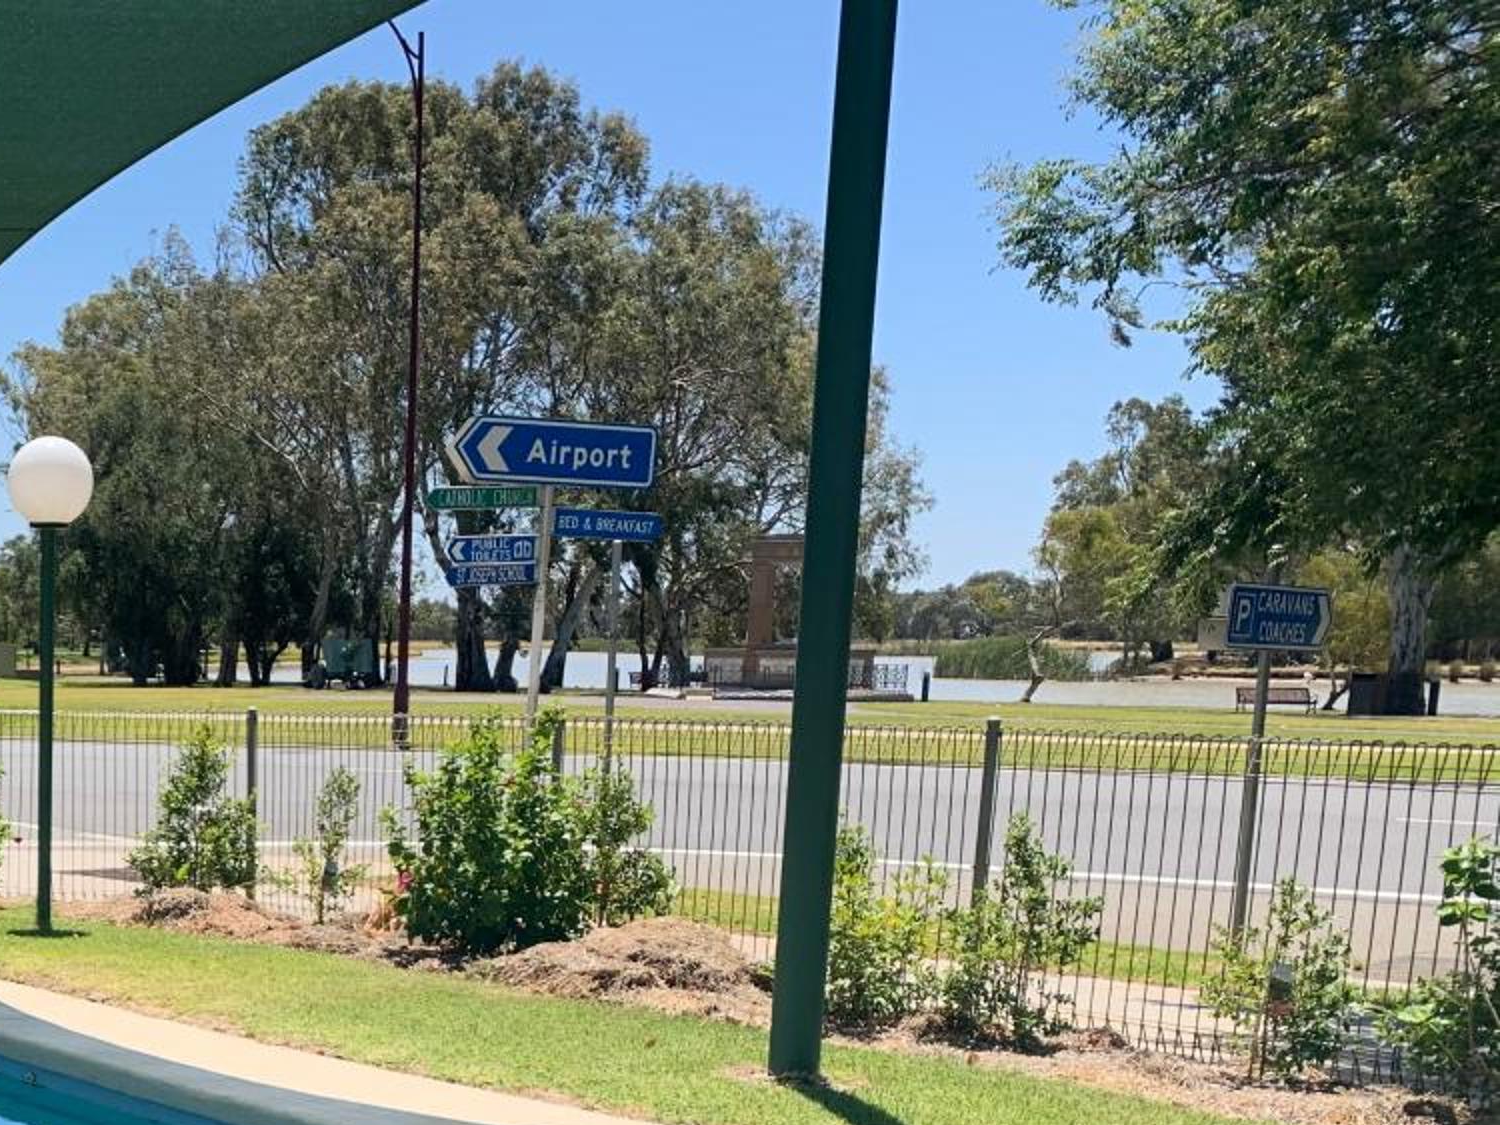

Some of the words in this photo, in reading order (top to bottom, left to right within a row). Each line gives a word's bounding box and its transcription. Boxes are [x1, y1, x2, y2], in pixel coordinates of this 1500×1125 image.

[526, 438, 632, 471] Airport
[558, 515, 579, 529] BED
[583, 517, 592, 531] &
[596, 517, 654, 534] BREAKFAST
[471, 537, 511, 550] PUBLIC
[471, 549, 512, 561] TOILETS
[1236, 599, 1251, 631] P
[1258, 591, 1316, 616] CARAVANS
[1259, 620, 1305, 643] COACHES
